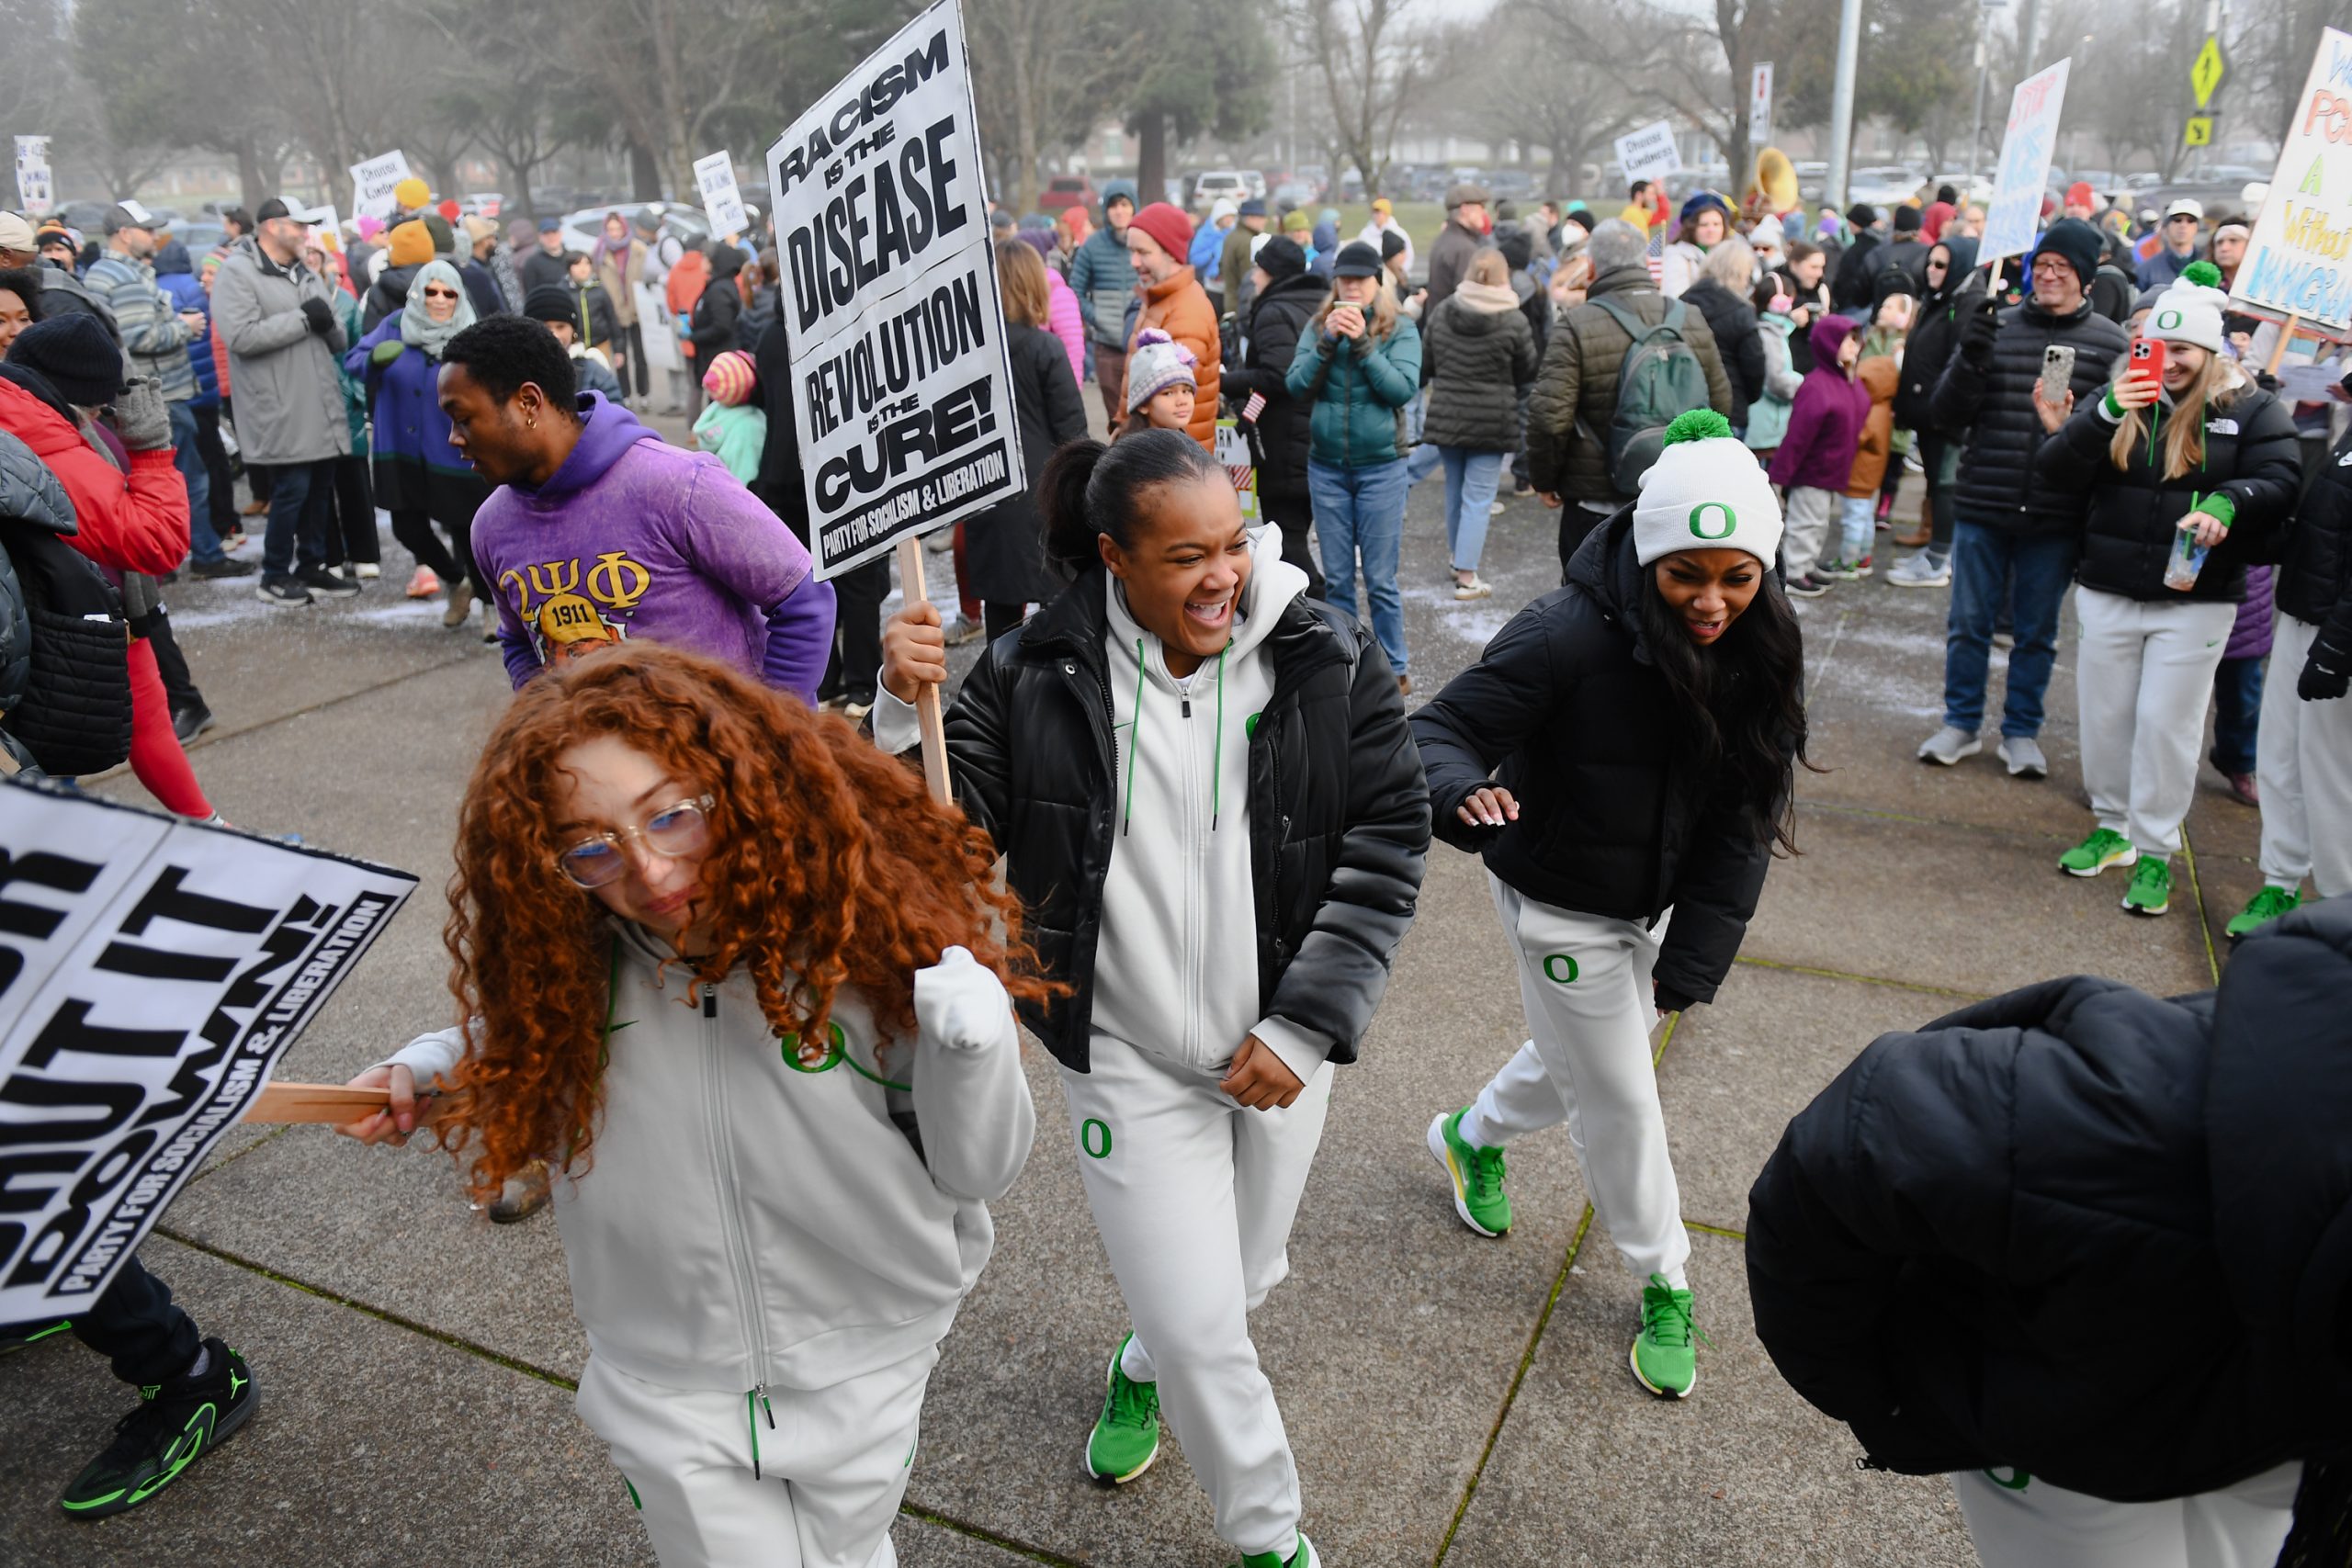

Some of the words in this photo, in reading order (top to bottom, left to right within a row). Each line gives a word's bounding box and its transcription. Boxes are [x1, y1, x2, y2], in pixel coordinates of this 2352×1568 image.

[779, 28, 949, 197] RACISM
[824, 164, 843, 190] IS
[844, 119, 895, 168] THE
[787, 114, 967, 334] DISEASE
[805, 269, 985, 444] REVOLUTION
[867, 413, 879, 434] IS
[879, 393, 920, 422] THE
[815, 374, 997, 513] CURE!
[822, 523, 851, 559] PARTY
[850, 512, 870, 545] FOR
[867, 489, 921, 537] SOCIALISM
[922, 484, 937, 511] &
[935, 450, 1005, 504] LIBERATION
[1689, 502, 1736, 538] O
[552, 604, 591, 627] 1911
[92, 863, 280, 983] IT
[1544, 953, 1579, 983] O
[0, 998, 189, 1271] HUT
[5, 893, 339, 1289] DOWN!
[59, 1221, 135, 1292] PARTY
[115, 1173, 173, 1219] FOR
[151, 1059, 263, 1172] SOCIALISM
[246, 1026, 286, 1055] &
[266, 899, 386, 1022] LIBERATION
[1081, 1118, 1112, 1158] O
